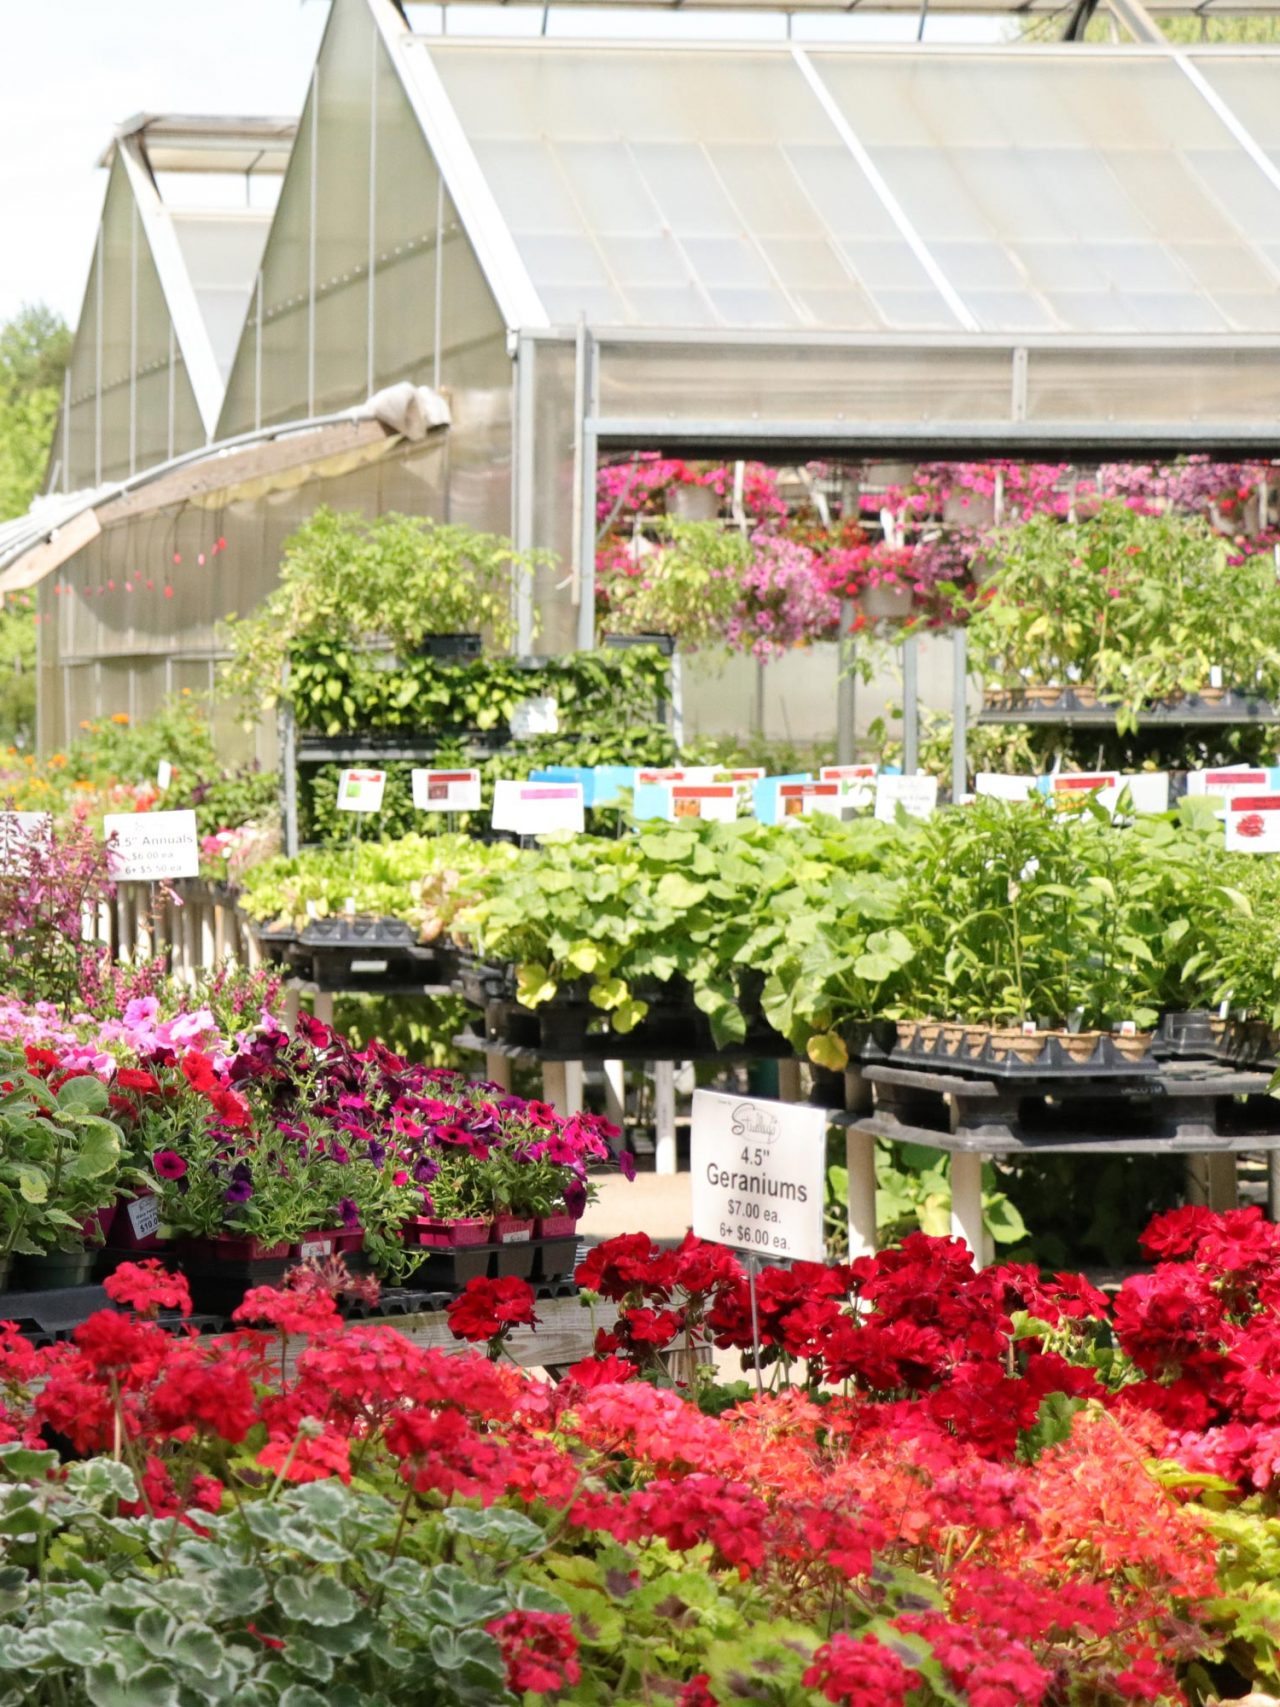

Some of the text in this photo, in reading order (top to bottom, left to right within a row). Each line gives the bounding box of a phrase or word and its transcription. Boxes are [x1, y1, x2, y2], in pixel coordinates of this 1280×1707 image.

[142, 834, 193, 846] Annuals
[741, 1146, 770, 1167] 4.5"
[706, 1162, 808, 1203] Geraniums
[727, 1199, 782, 1223] $7.00 ea.
[720, 1222, 791, 1251] 6+ $6.00 ea.
